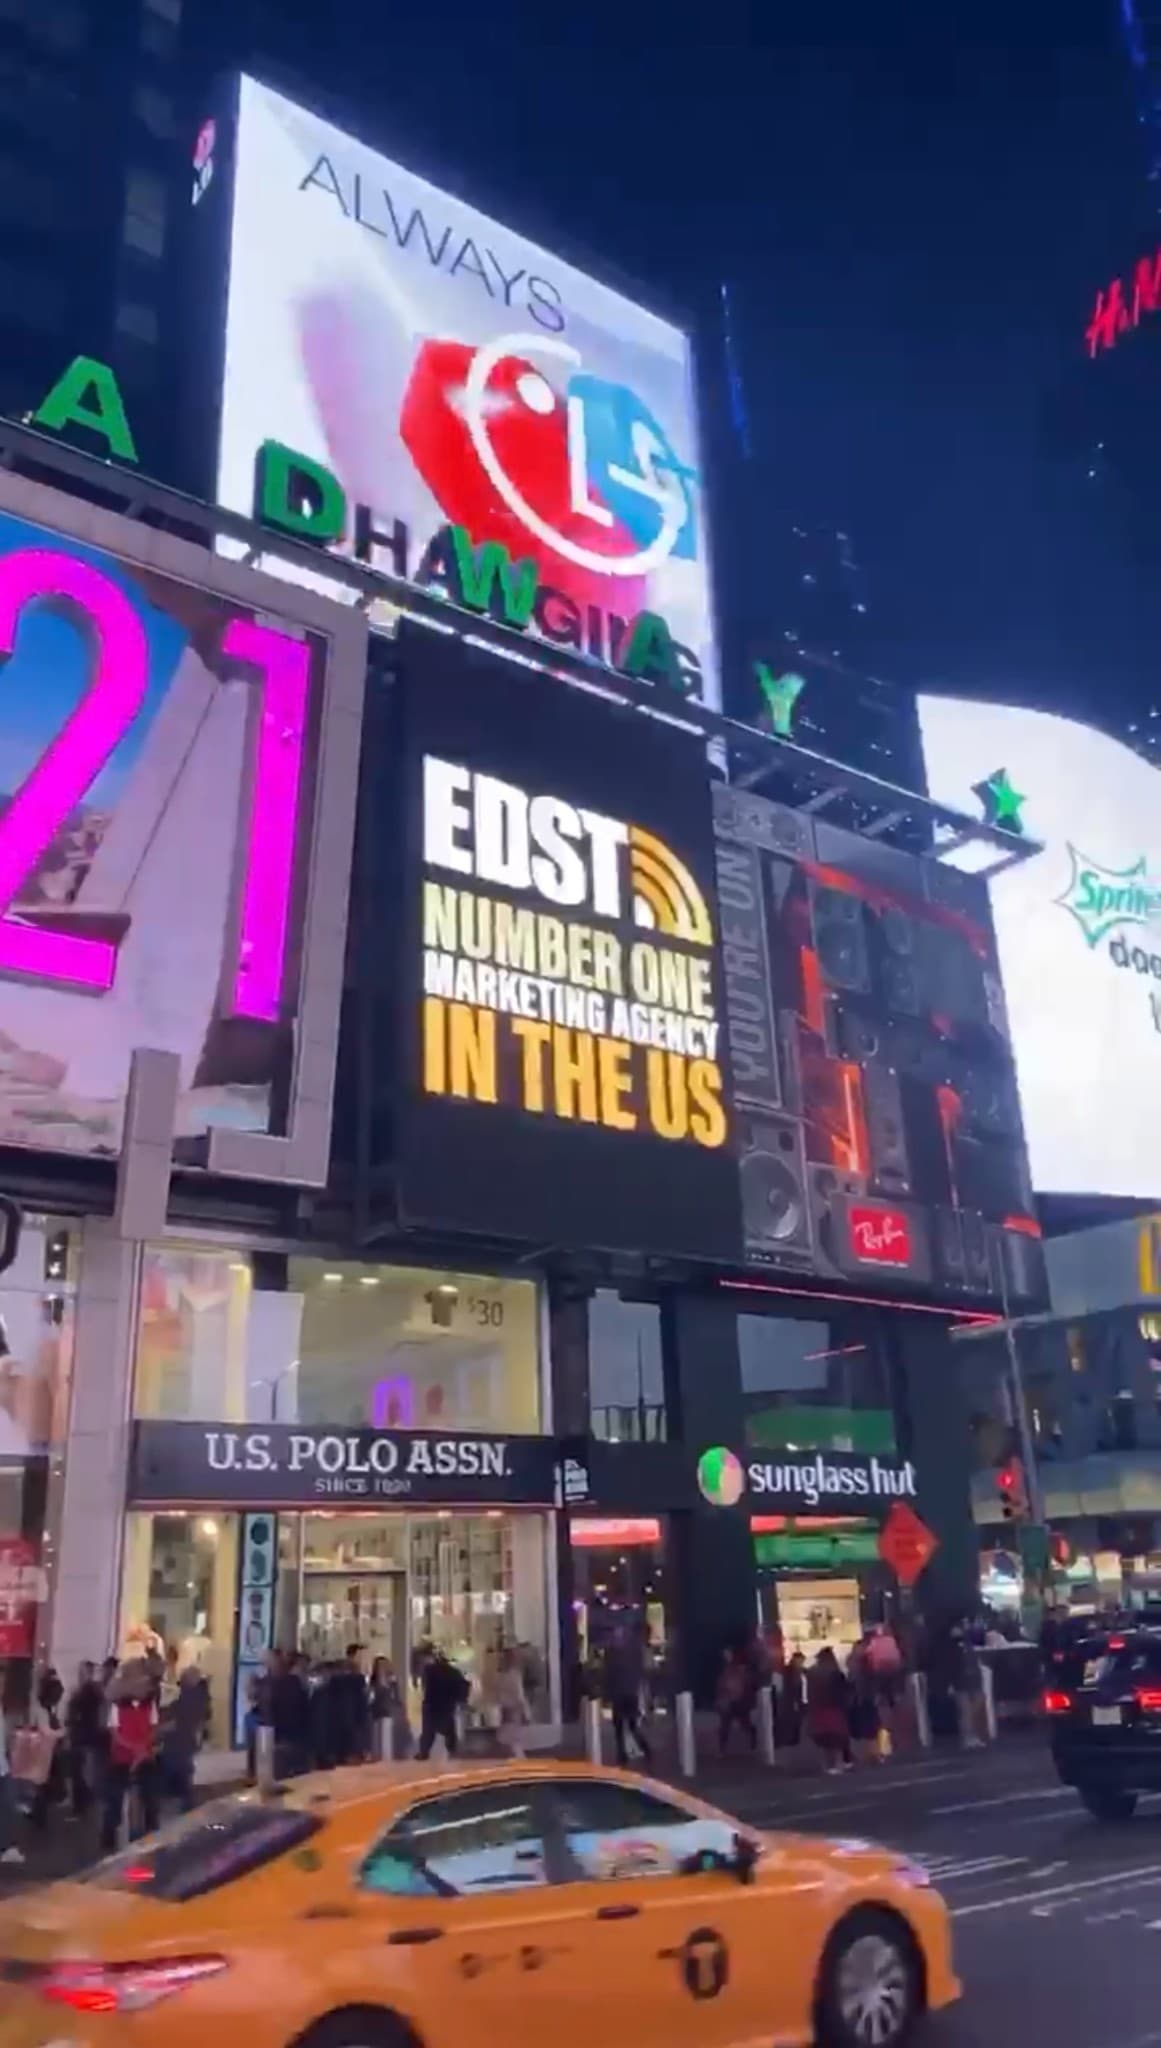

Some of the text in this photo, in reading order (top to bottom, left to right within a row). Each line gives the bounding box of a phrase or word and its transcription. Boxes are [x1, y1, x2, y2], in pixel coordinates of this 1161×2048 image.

[298, 153, 565, 332] ALWAYS
[0, 548, 310, 1022] 21
[422, 753, 630, 918] EDST
[422, 880, 715, 1018] NUMBER ONE
[423, 951, 721, 1061] MARKETING AGENCY
[423, 995, 727, 1149] IN THE US
[205, 1432, 514, 1477] U.S. POLO ASSN.
[748, 1453, 918, 1506] sunglass hut
